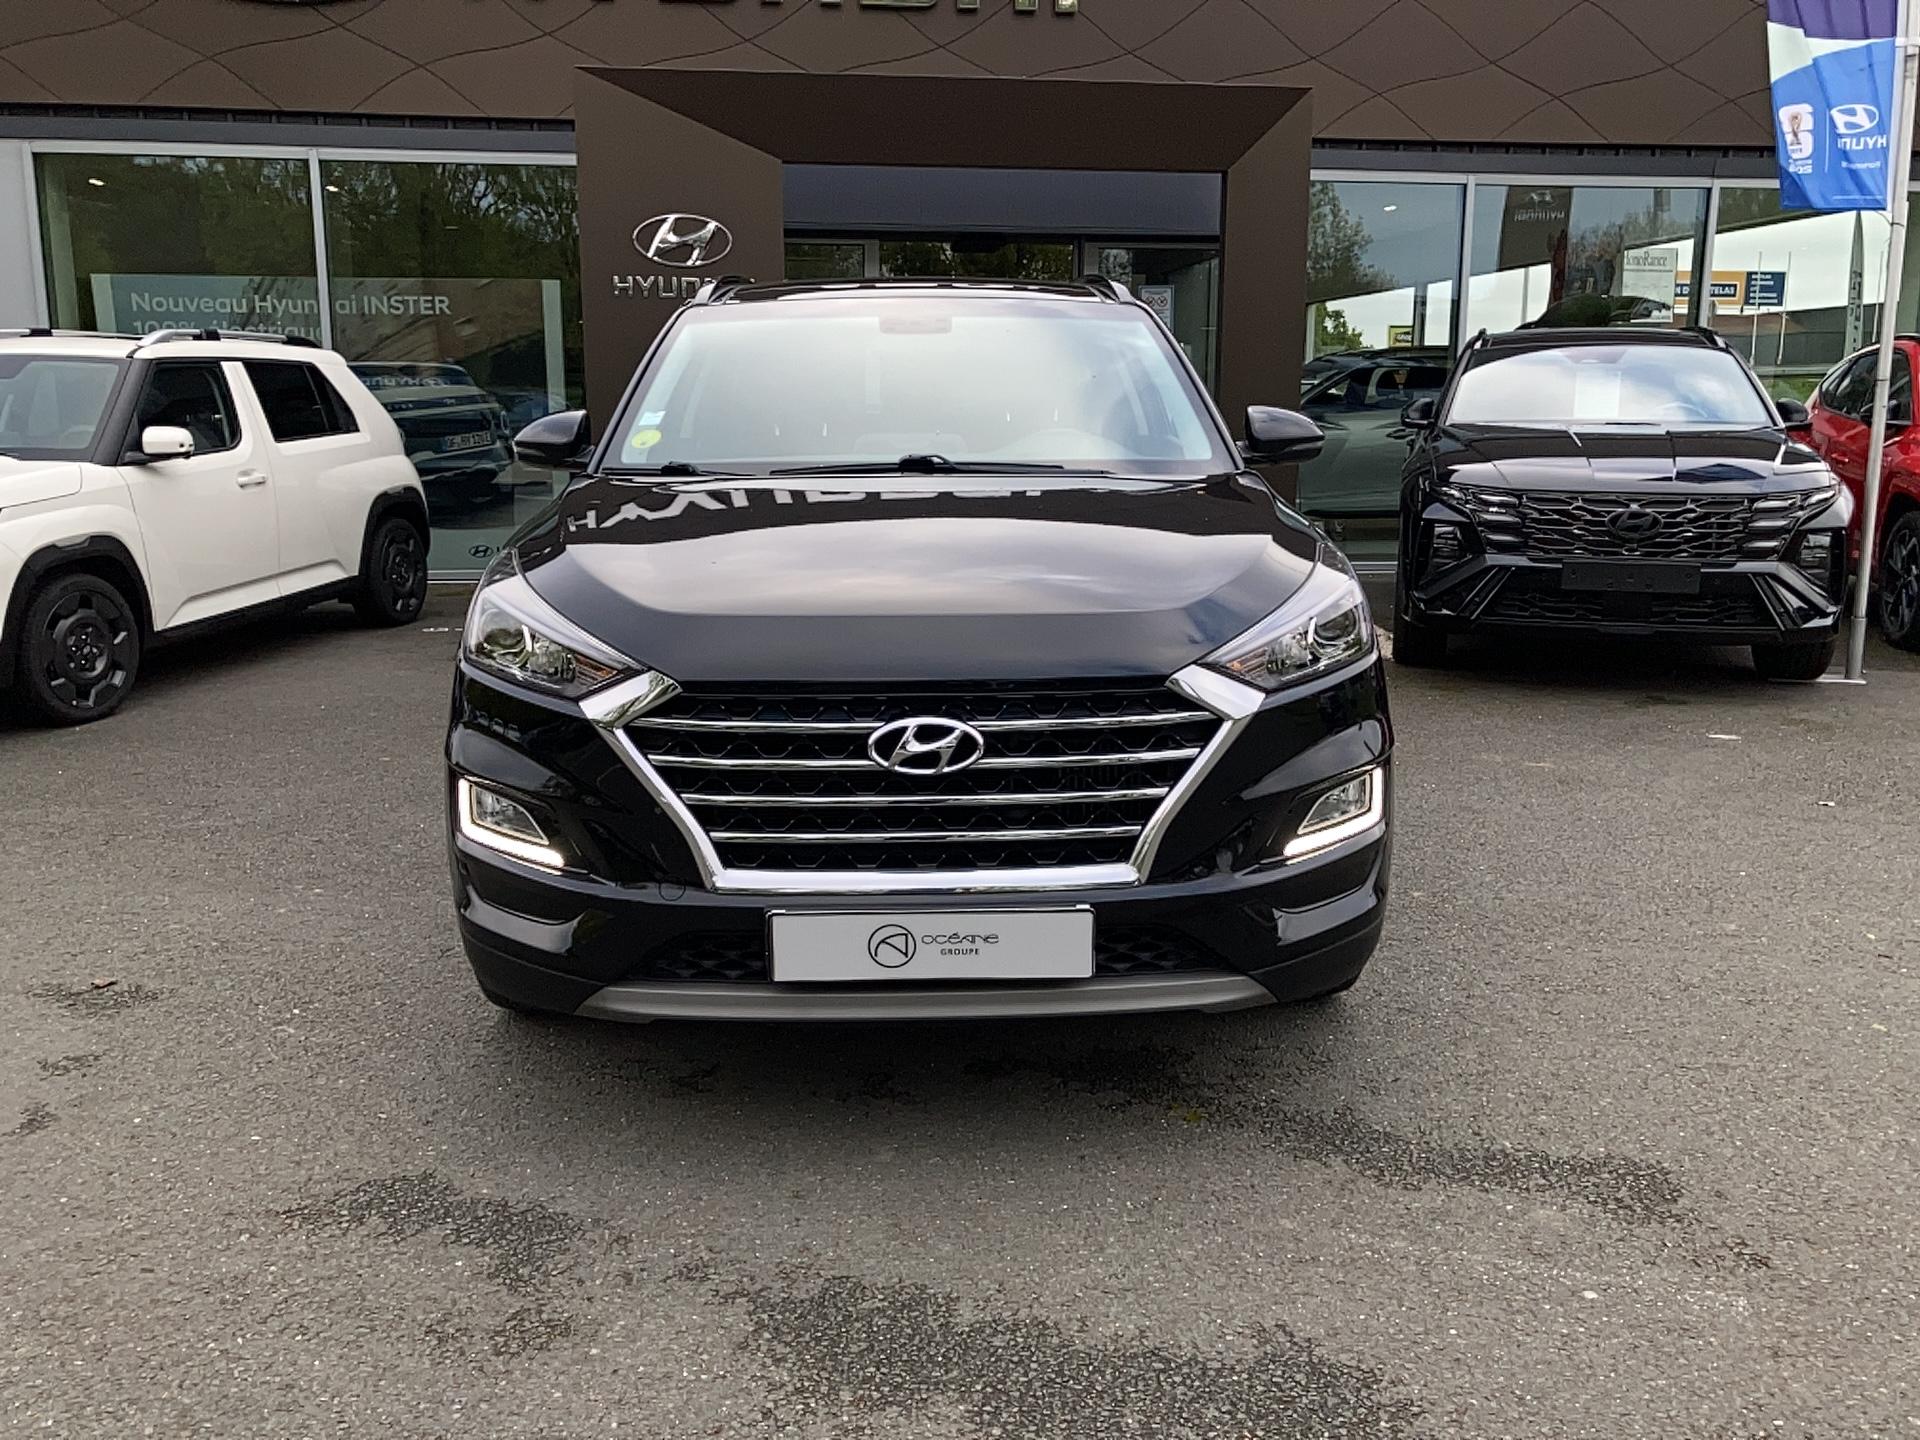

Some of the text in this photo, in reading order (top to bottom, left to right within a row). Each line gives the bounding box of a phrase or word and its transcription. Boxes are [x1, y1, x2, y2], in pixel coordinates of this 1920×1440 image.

[130, 292, 452, 318] Nouveau Hyunai INSTER
